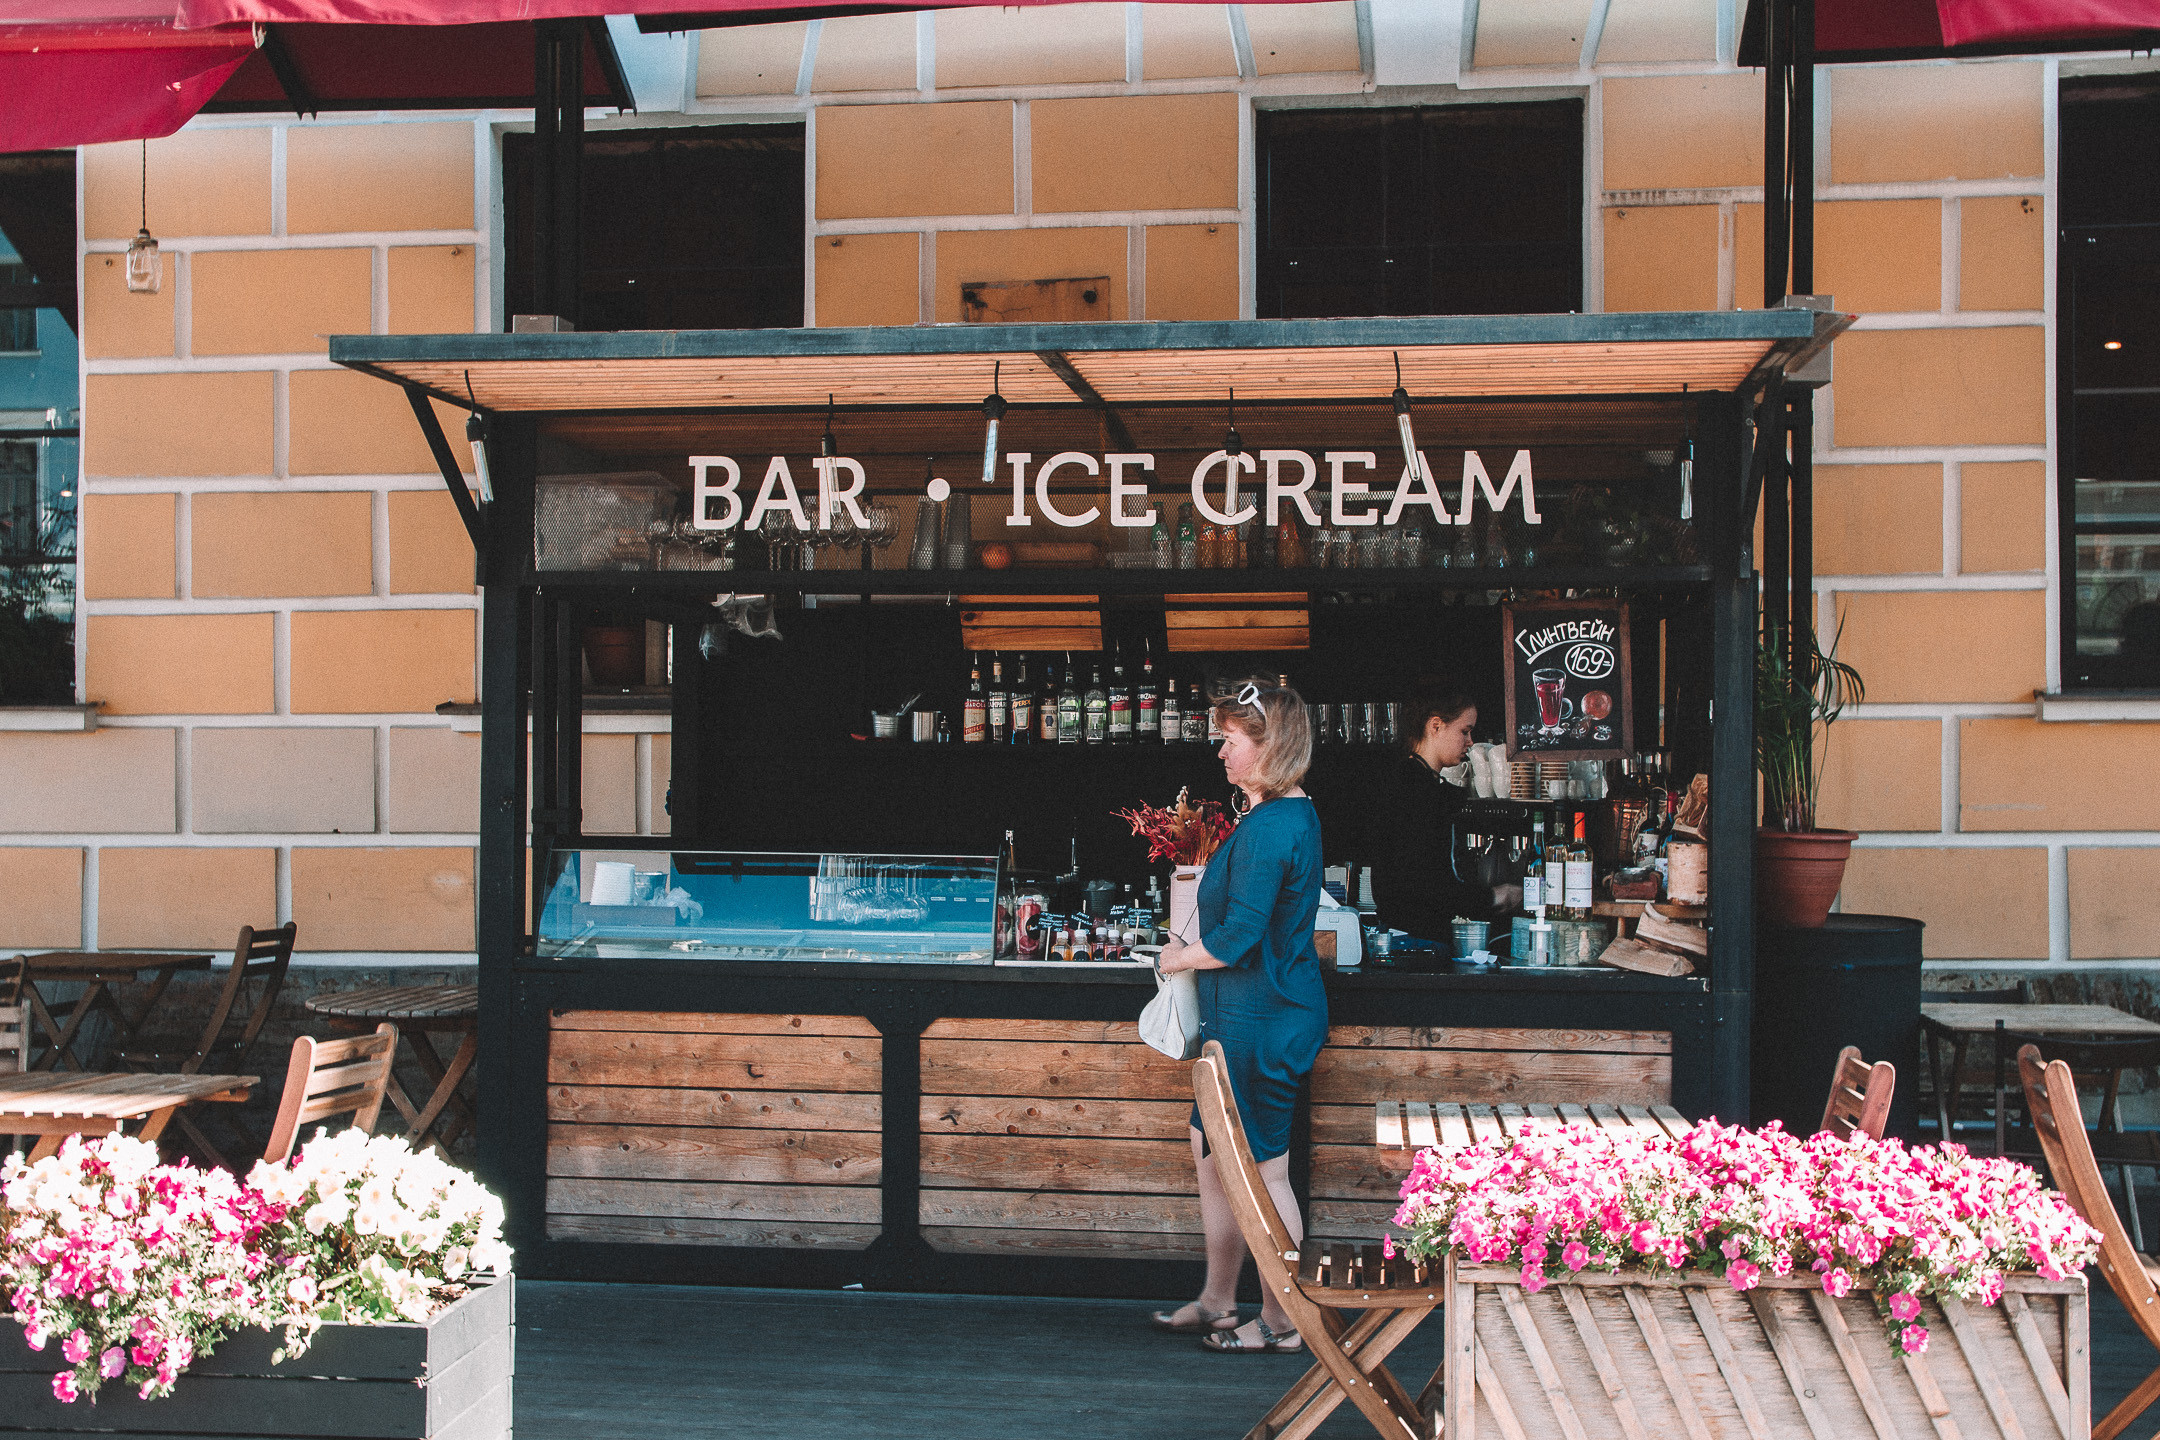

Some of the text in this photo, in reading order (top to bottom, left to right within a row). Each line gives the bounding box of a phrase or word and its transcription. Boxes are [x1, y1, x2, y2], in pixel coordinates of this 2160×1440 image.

[688, 448, 1542, 531] BAR ICE CREAM
